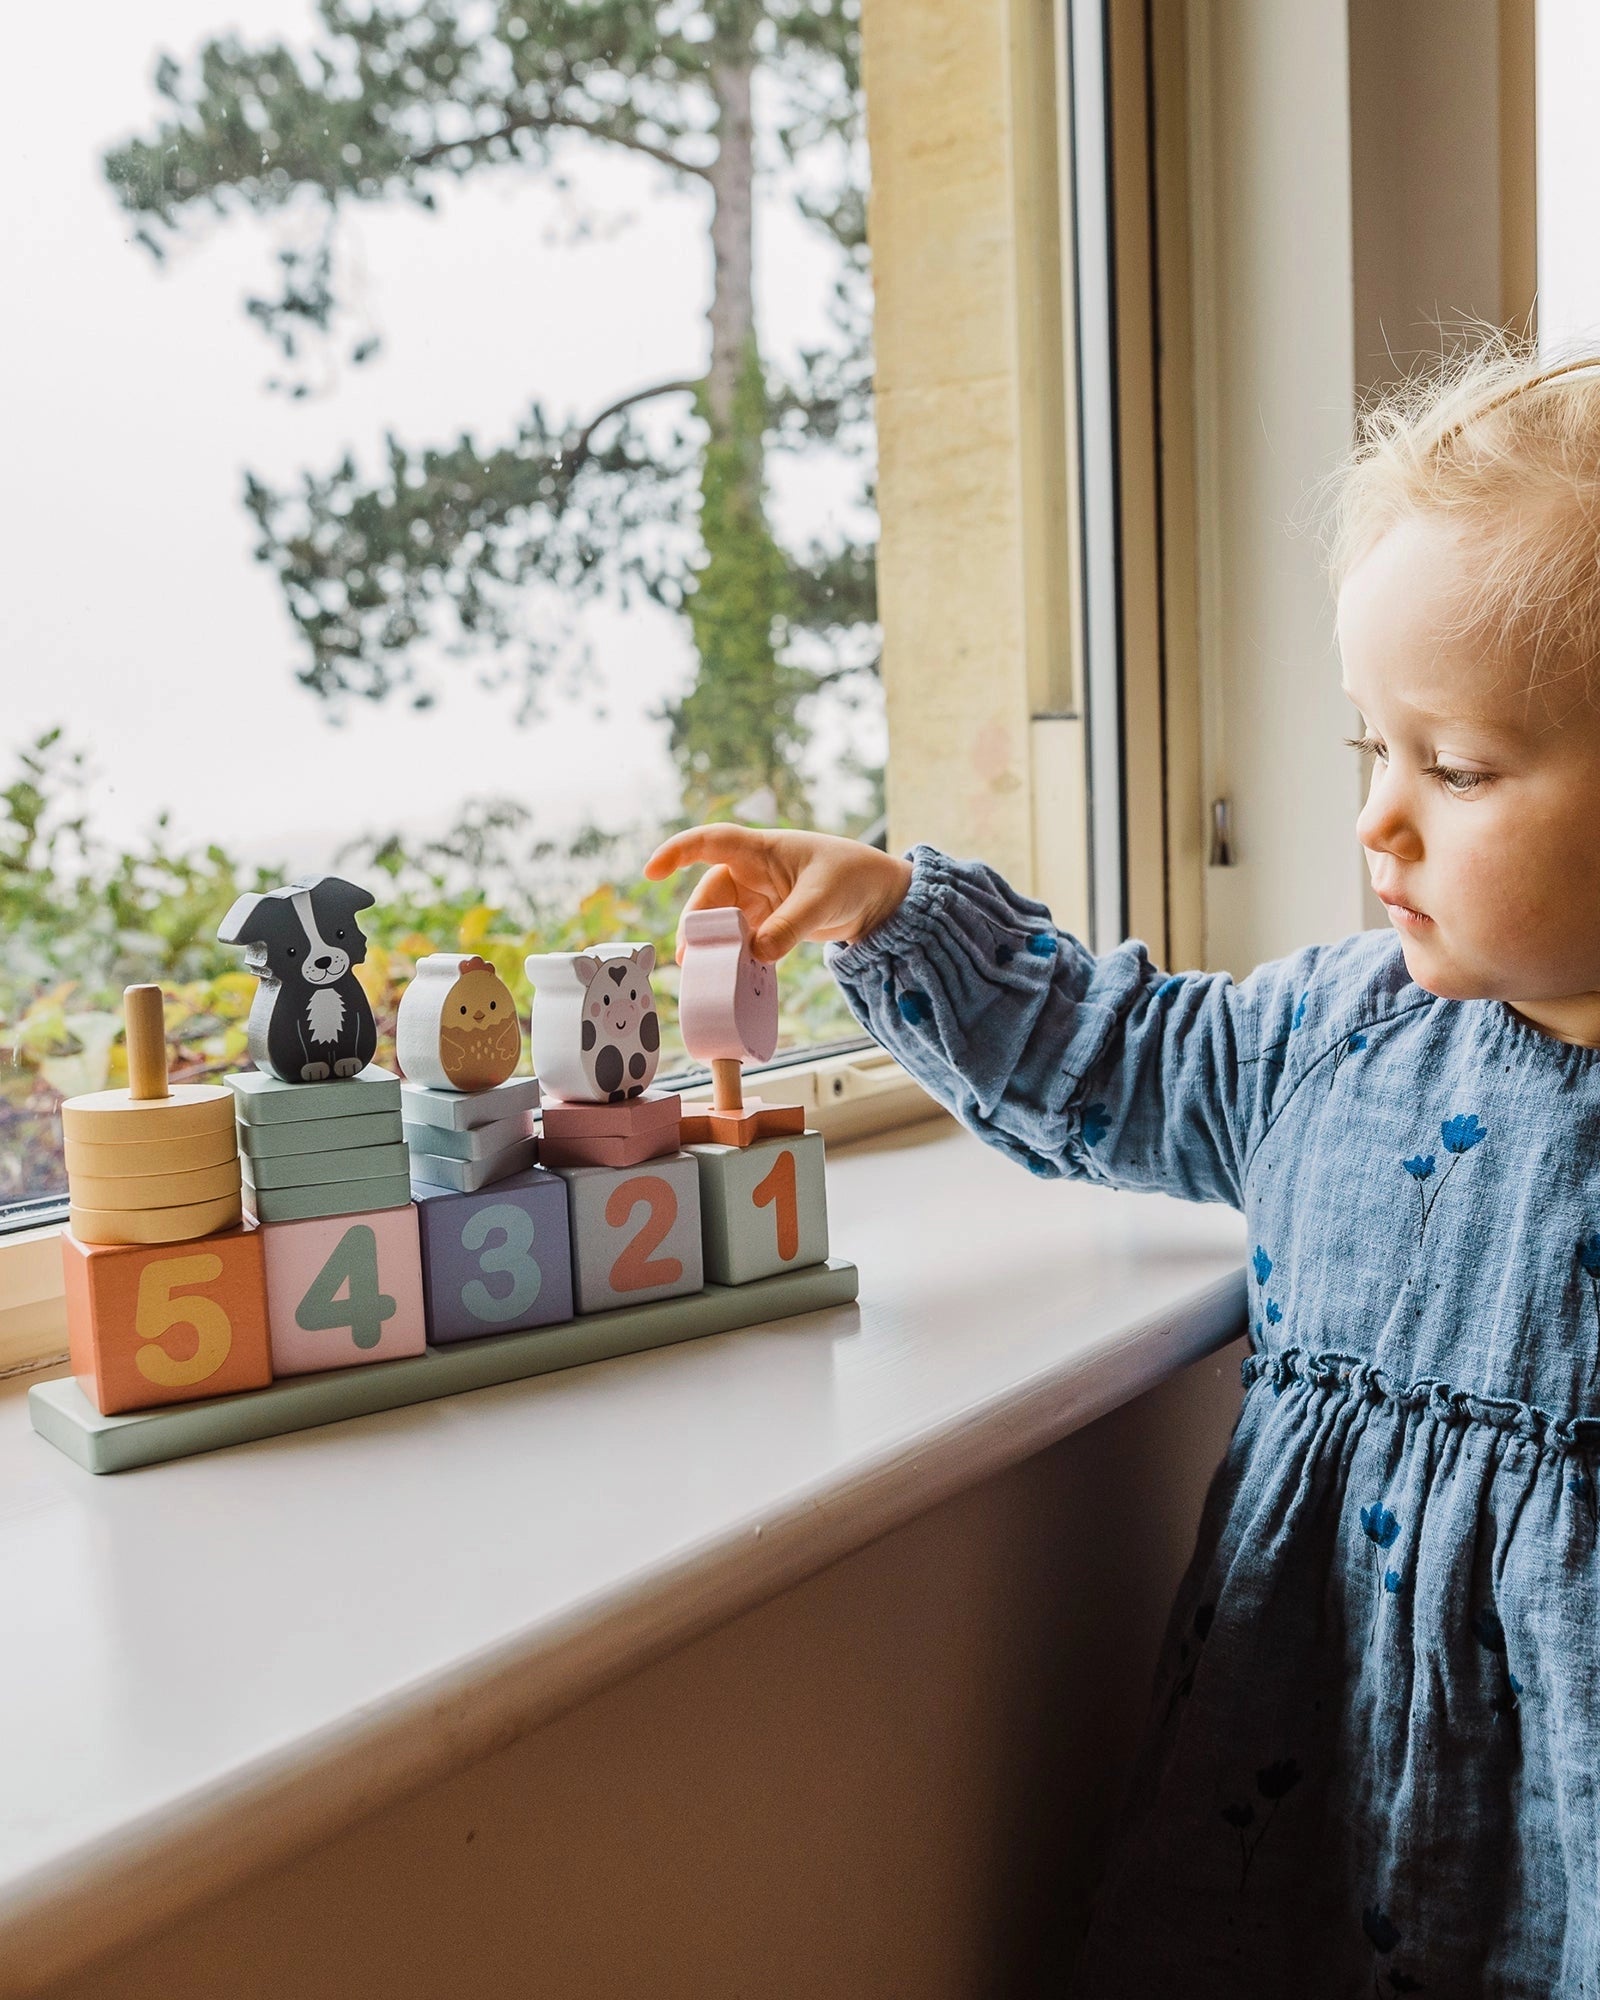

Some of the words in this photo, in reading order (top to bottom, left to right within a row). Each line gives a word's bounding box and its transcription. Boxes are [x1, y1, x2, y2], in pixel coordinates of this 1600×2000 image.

[461, 1204, 542, 1322] 3
[605, 1175, 683, 1292] 2
[752, 1150, 798, 1261] 1
[135, 1253, 232, 1387] 5
[295, 1225, 397, 1349] 4
